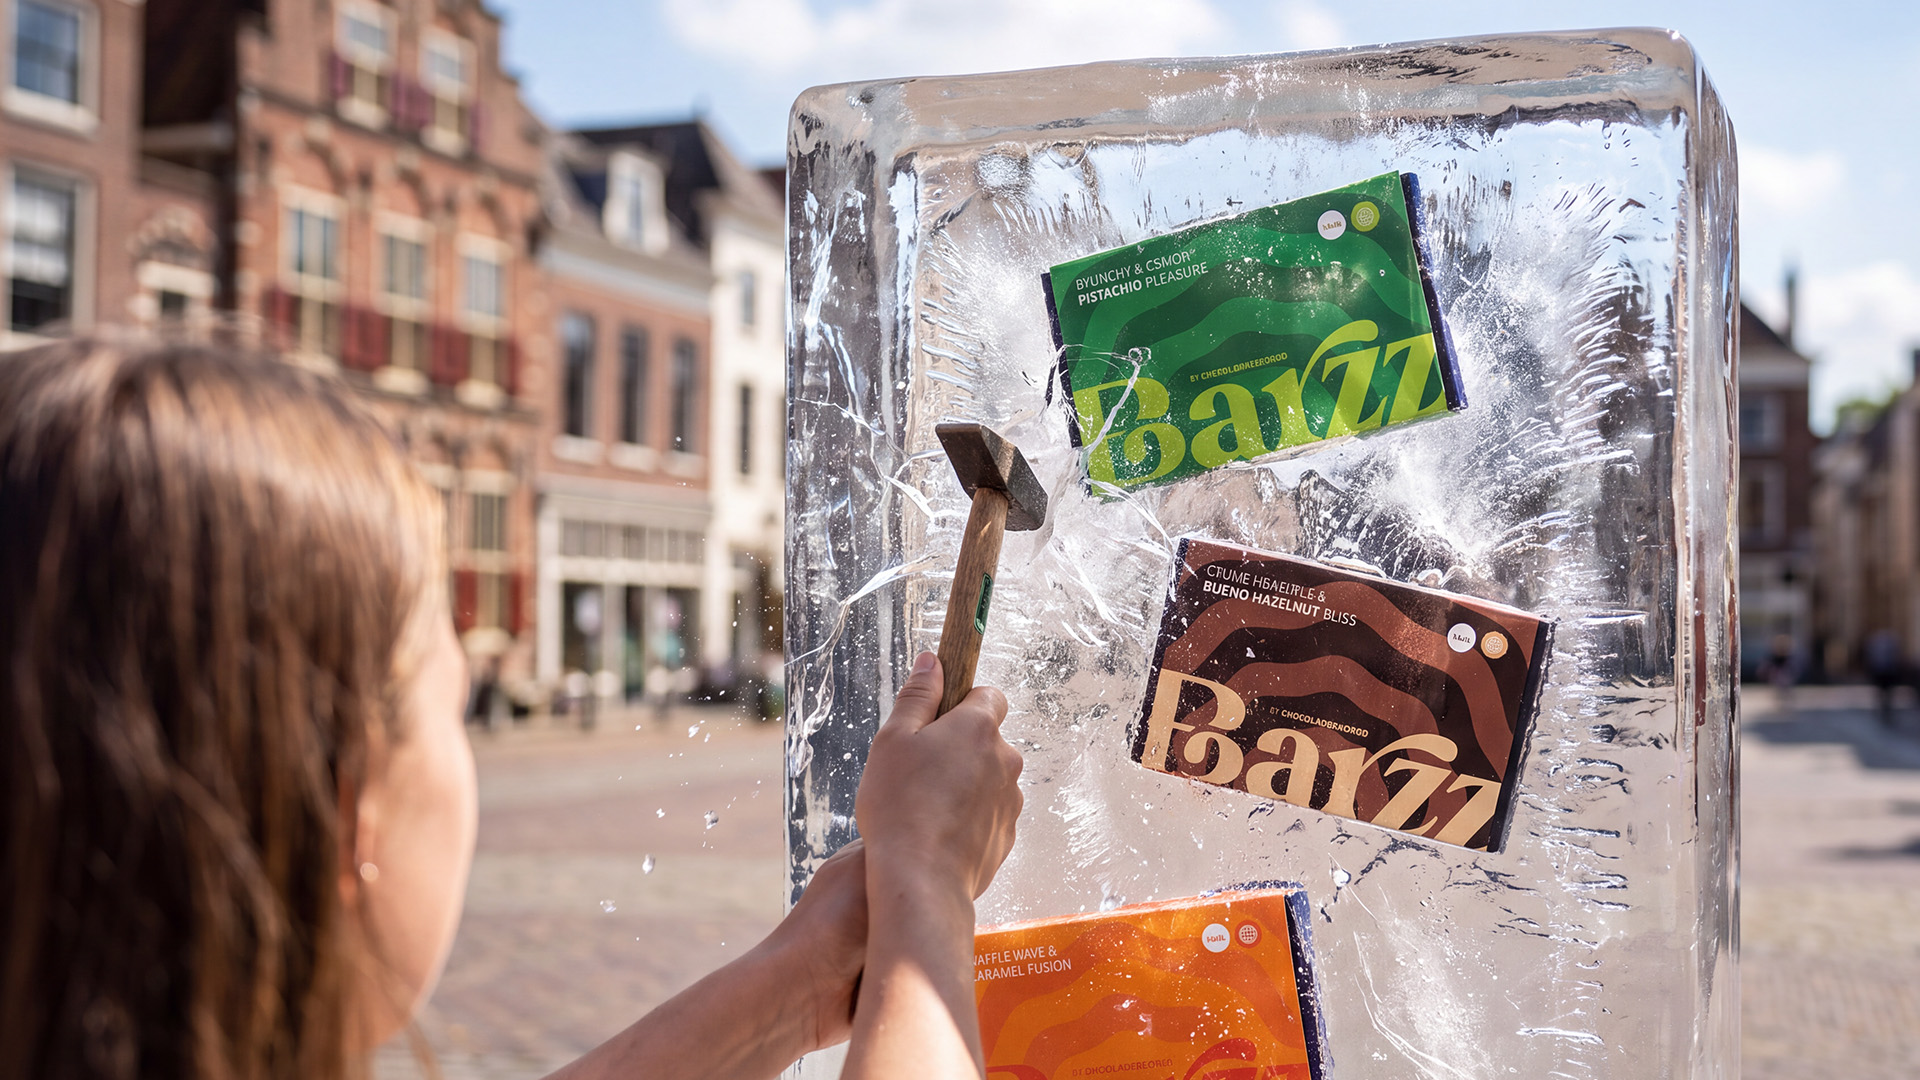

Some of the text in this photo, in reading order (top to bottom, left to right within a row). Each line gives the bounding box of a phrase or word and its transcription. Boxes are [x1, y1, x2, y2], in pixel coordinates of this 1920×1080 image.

[1077, 261, 1209, 306] PISTACHIO PLEASURE
[1134, 263, 1144, 275] &
[1072, 319, 1447, 499] Barzz
[1202, 580, 1357, 627] BUENO HAZELNUT BLISS
[1317, 590, 1327, 603] &
[1141, 668, 1502, 852] Barzz
[974, 958, 1072, 982] ARAMEL FUSION
[1012, 946, 1046, 962] WAVE
[1048, 944, 1058, 957] &
